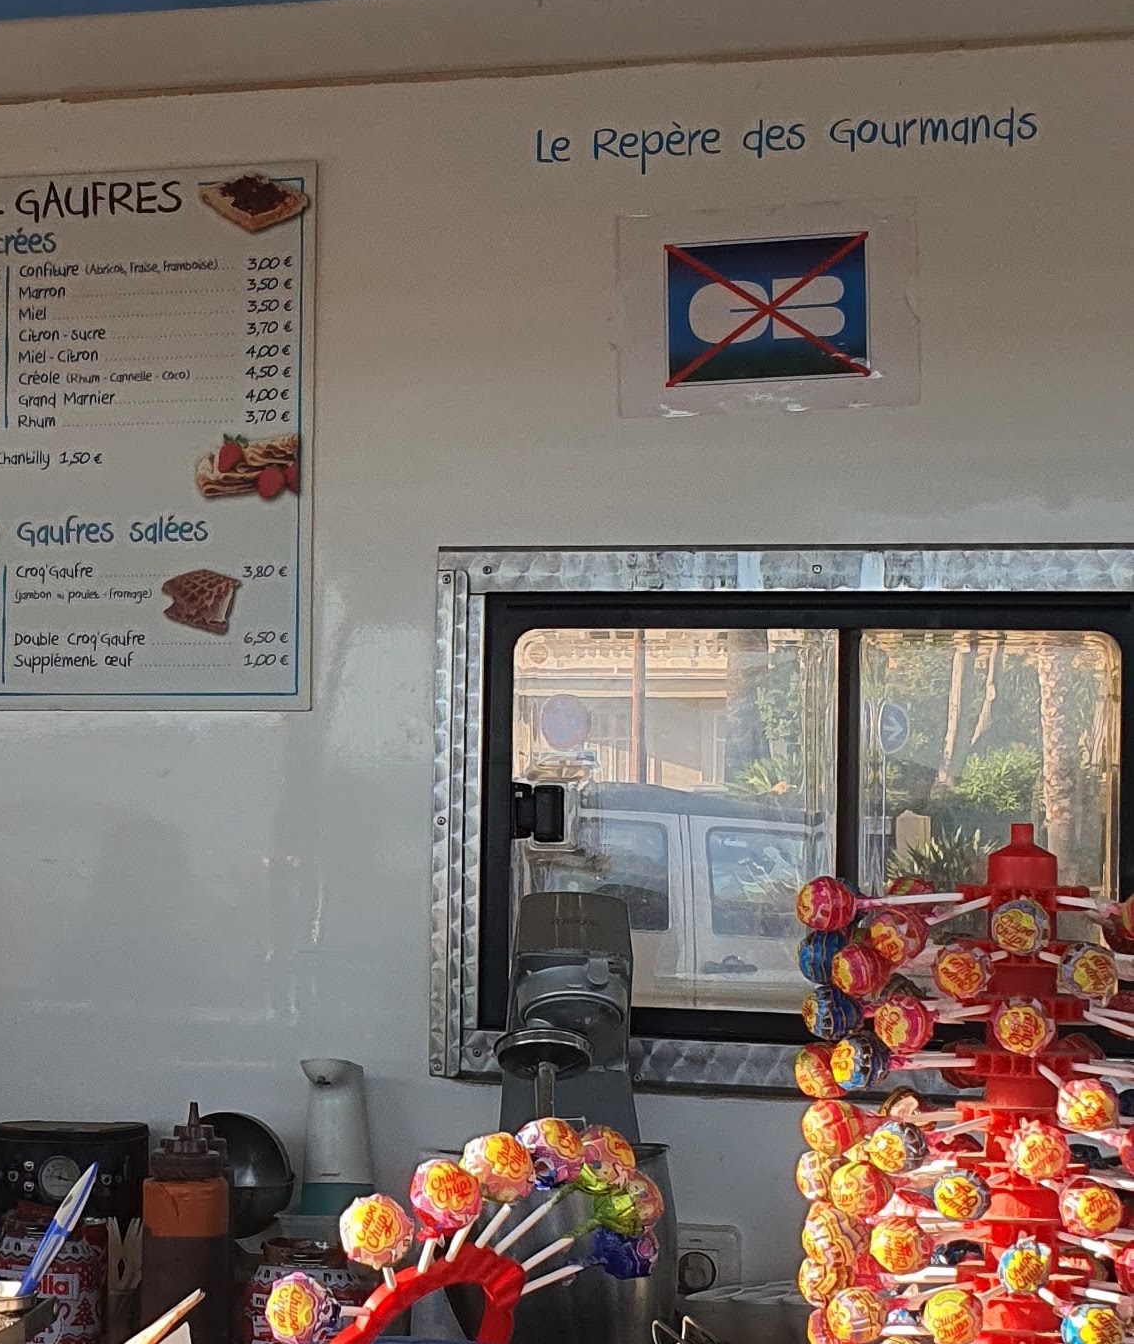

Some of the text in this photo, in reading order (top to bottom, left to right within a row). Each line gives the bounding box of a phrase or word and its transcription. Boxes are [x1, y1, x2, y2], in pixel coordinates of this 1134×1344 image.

[536, 107, 1039, 175] Le Repère des Gourmands
[15, 180, 183, 224] GAUFRES
[19, 263, 79, 277] Confiture
[247, 258, 280, 271] 3,00
[247, 278, 279, 291] 3,50
[18, 287, 66, 299] Marron
[247, 299, 279, 313] 3,50
[18, 307, 47, 320] Miel
[247, 321, 278, 335] 3,70
[19, 330, 60, 342] Citron
[18, 350, 99, 364] Miel Citron
[246, 345, 279, 358] 4,00
[19, 372, 60, 385] Créole
[245, 366, 278, 379] 4,50
[19, 392, 116, 408] Grand Marnier
[245, 388, 278, 402] 4,00
[18, 415, 56, 428] Rhum
[245, 410, 276, 423] 3,70
[59, 451, 90, 465] 1,50
[17, 515, 115, 547] Gaufres
[242, 566, 274, 578] 3,80
[14, 632, 59, 647] Double
[244, 632, 275, 644] 6,50
[14, 653, 97, 674] Supplément
[244, 655, 276, 667] 1,00
